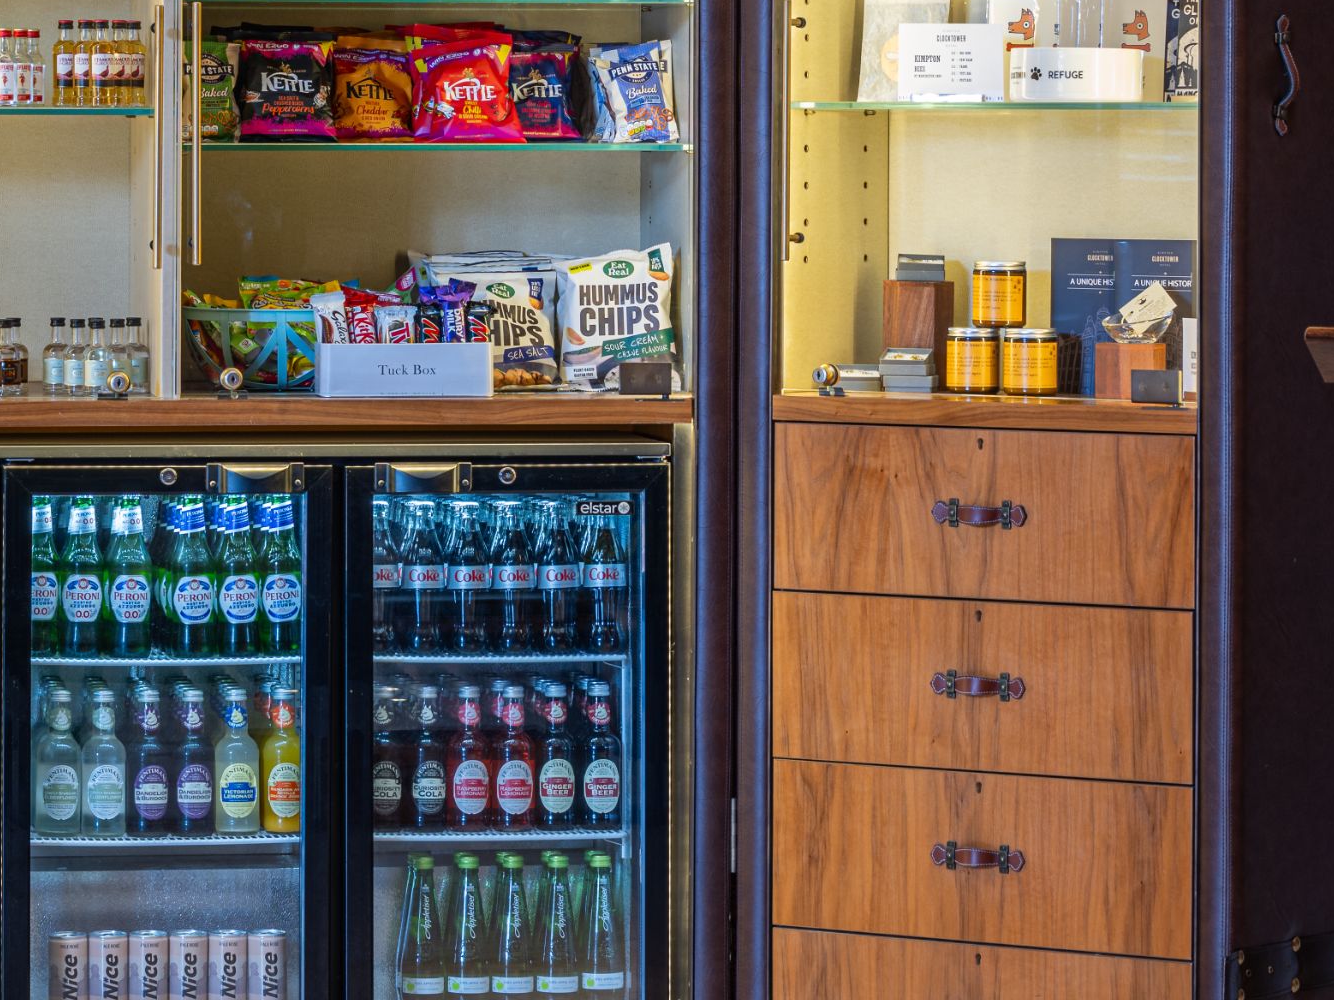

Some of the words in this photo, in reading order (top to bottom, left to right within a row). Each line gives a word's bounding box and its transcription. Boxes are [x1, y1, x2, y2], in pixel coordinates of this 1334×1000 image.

[914, 54, 941, 63] KIMPTON
[207, 65, 233, 74] STATE
[611, 63, 634, 78] PENN
[634, 62, 659, 72] STATE
[1048, 70, 1084, 79] REFUGE
[261, 71, 315, 93] KETTLE
[443, 78, 497, 102] KETTLE
[514, 80, 563, 102] KETTLE
[626, 86, 658, 99] Baked
[262, 102, 315, 115] Peppercorns
[356, 104, 388, 116] Cheddar
[608, 267, 630, 276] Real
[611, 261, 627, 270] Eat
[493, 283, 508, 291] Eat
[1076, 278, 1102, 287] UNIQUE
[491, 288, 510, 298] Real
[579, 281, 659, 306] HUMMUS
[445, 309, 455, 335] MILK
[454, 308, 463, 339] DAIRY
[579, 304, 660, 337] CHIPS
[604, 341, 626, 352] SOUR
[630, 336, 659, 347] CREAM
[507, 350, 524, 361] SEA
[526, 347, 549, 358] SALT
[378, 364, 408, 376] Tuck
[413, 364, 437, 376] Box
[580, 502, 617, 514] elstar
[408, 569, 440, 582] Coke
[454, 569, 486, 583] Coke
[499, 569, 530, 582] Coke
[546, 568, 577, 582] Coke
[65, 590, 100, 600] PERONI
[114, 591, 148, 601] PERONI
[177, 592, 212, 602] PERONI
[223, 592, 257, 602] PERONI
[34, 607, 48, 615] 0.0
[75, 610, 90, 618] 0.0
[424, 894, 432, 940] Appletiser
[468, 894, 476, 939] Appletiser
[63, 954, 78, 1000] Nice
[103, 953, 119, 1000] Nice
[142, 952, 158, 1000] Nice
[182, 952, 197, 999] Nice
[221, 951, 237, 999] Nice
[263, 951, 279, 999] Nice
